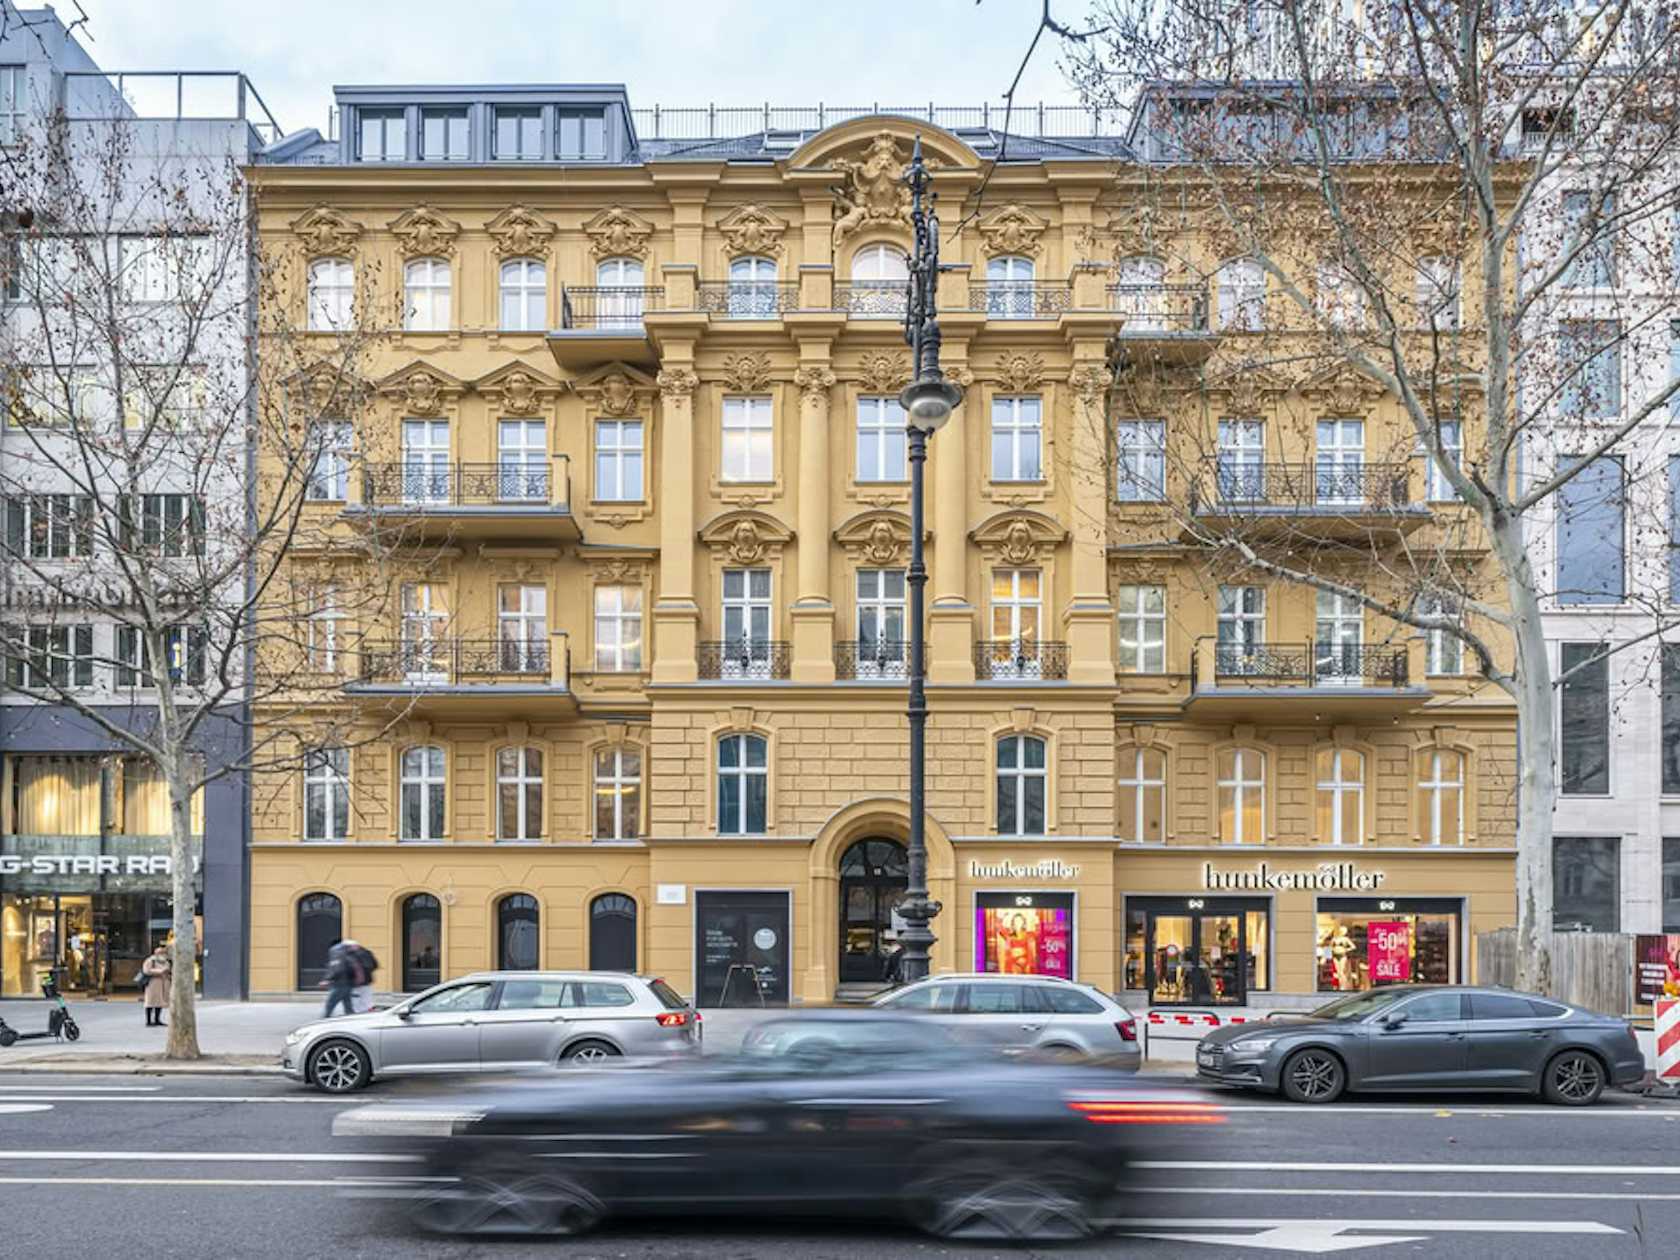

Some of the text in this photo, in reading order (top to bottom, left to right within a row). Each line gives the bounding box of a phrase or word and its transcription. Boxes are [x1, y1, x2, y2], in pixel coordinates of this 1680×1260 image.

[0, 855, 200, 874] G-STAR RA
[971, 860, 1079, 878] hunkemöller
[1205, 863, 1385, 889] hunkemöller
[1376, 963, 1400, 976] SALE
